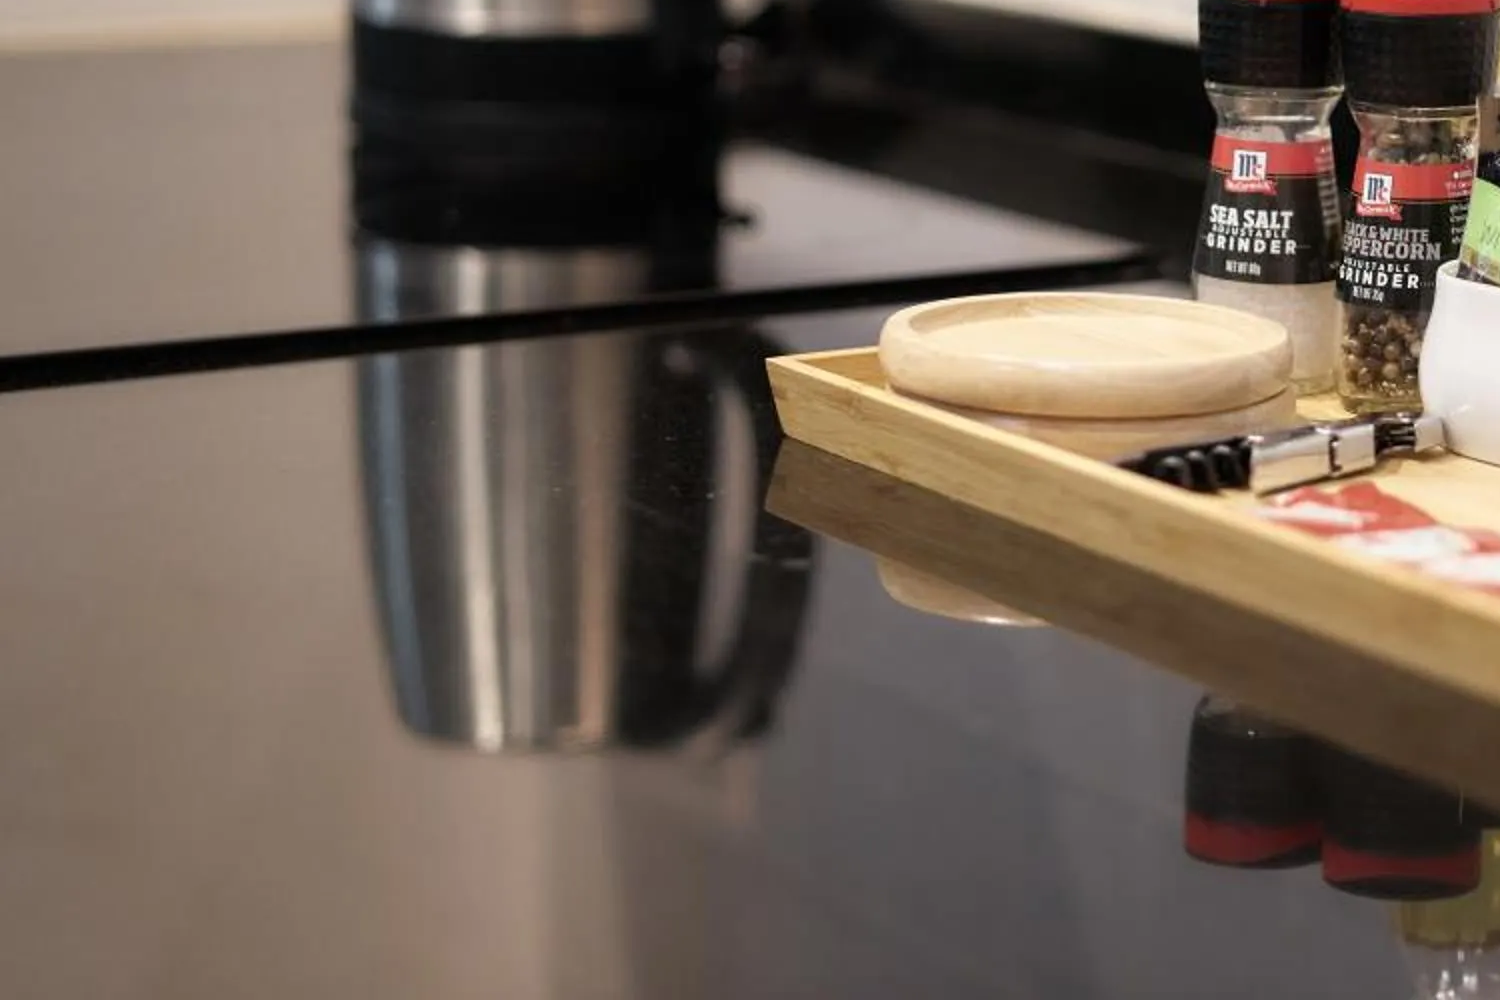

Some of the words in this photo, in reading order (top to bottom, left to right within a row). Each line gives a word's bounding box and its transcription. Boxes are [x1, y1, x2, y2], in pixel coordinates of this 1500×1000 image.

[1210, 203, 1239, 227] SEA
[1243, 209, 1294, 229] SALT
[1206, 231, 1297, 255] GRINDER
[1211, 222, 1288, 240] ADJUSTABLE
[1339, 263, 1420, 289] GRINDER
